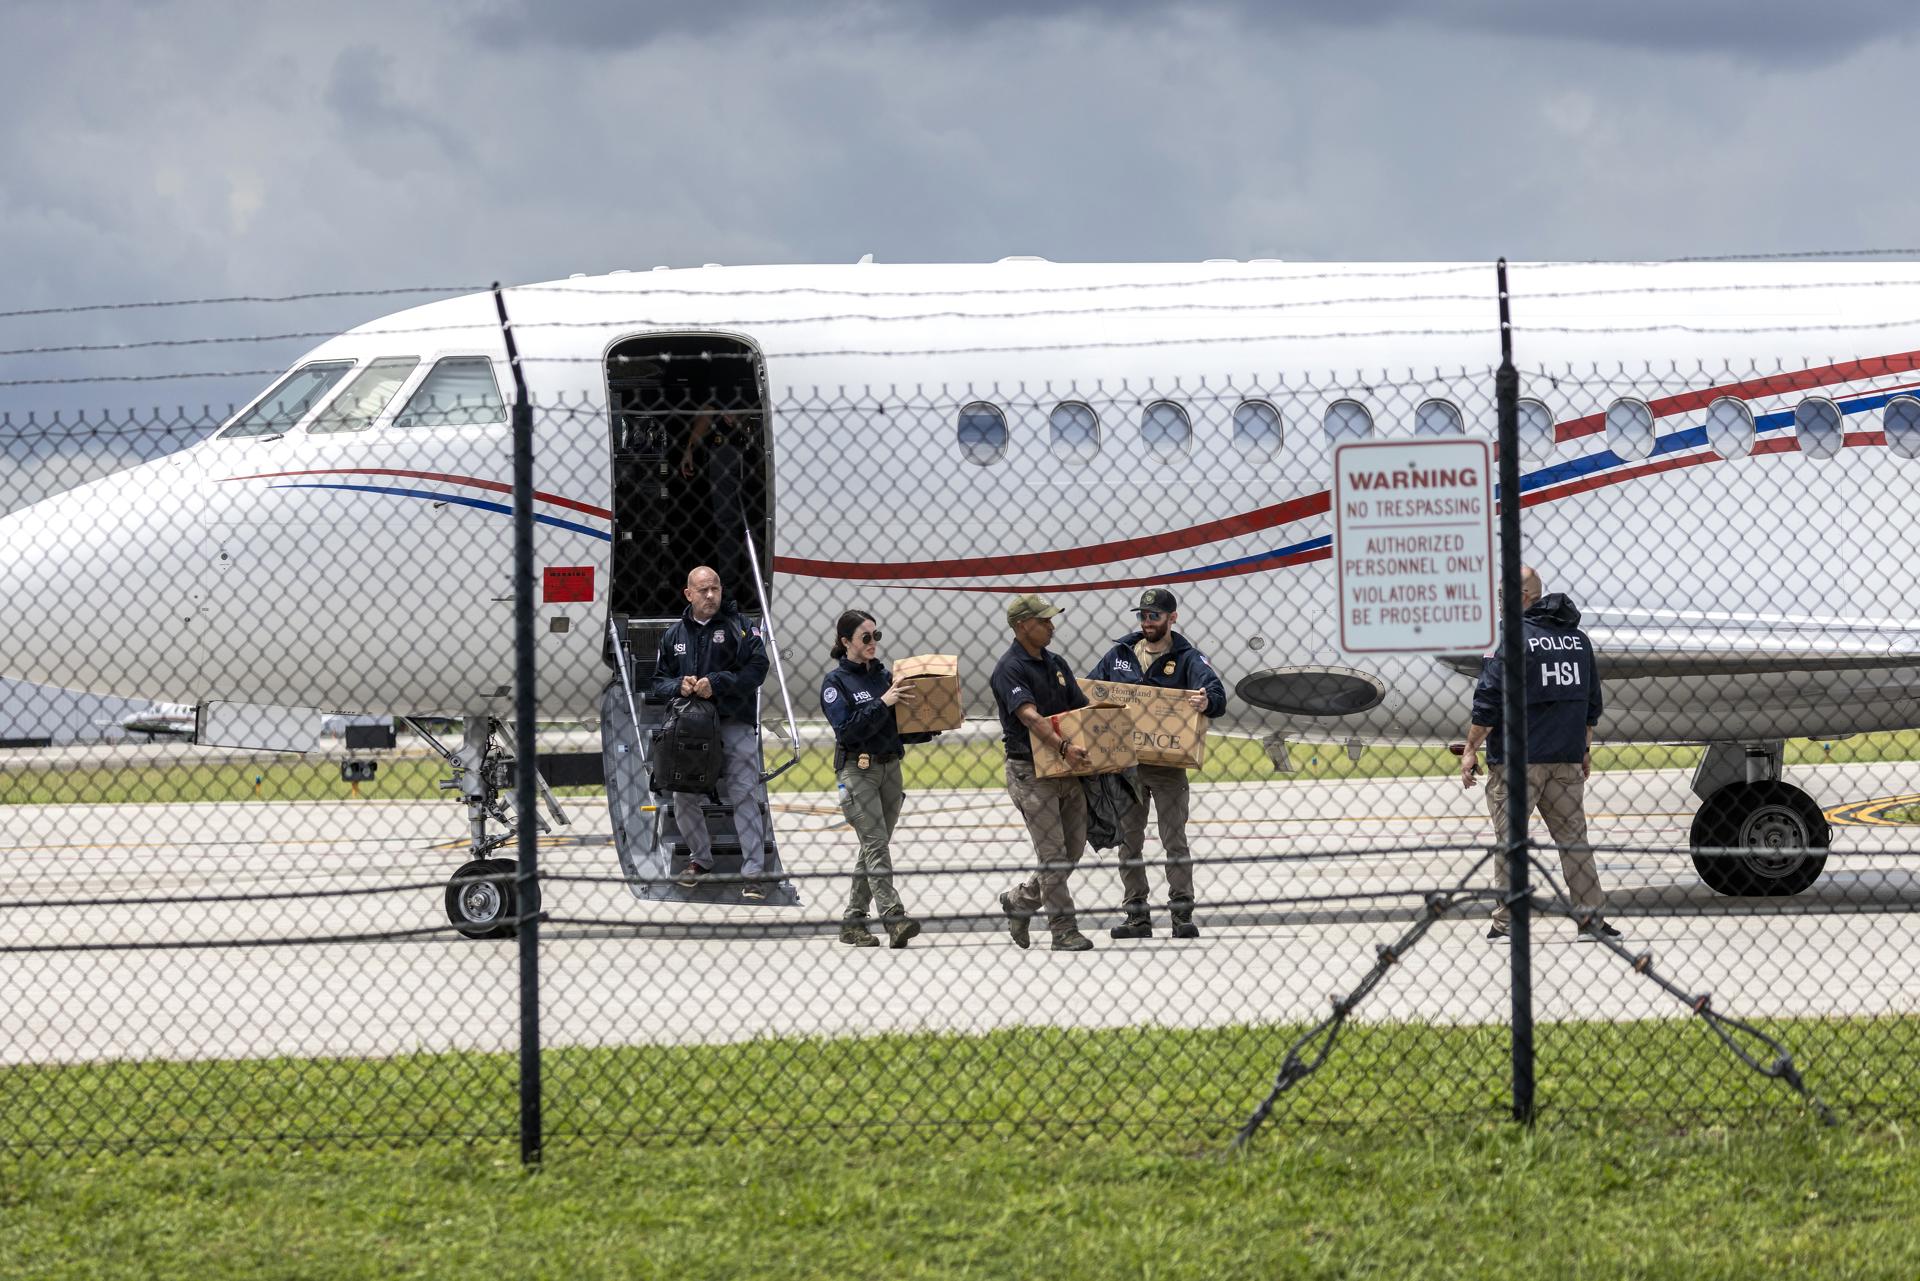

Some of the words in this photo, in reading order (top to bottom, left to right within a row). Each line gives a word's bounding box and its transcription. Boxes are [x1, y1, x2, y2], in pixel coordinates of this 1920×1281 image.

[1348, 468, 1478, 491] WARNING
[1346, 501, 1368, 519] NO
[1376, 497, 1481, 518] TRESPASSING
[1366, 534, 1464, 555] AUTHORIZED
[1345, 557, 1439, 576] PERSONNEL
[1446, 556, 1485, 573] ONLY
[1352, 584, 1438, 604] VIOLATORS
[1445, 583, 1480, 601] WILL
[1352, 608, 1372, 626] BE
[1380, 604, 1482, 625] PROSECUTED
[1528, 635, 1583, 652] POLICE
[1115, 657, 1132, 670] HSI
[1541, 661, 1581, 687] HSI
[852, 690, 872, 702] HSI
[1110, 695, 1142, 704] Security
[1111, 686, 1152, 698] Homeland
[1133, 731, 1181, 749] ENCE
